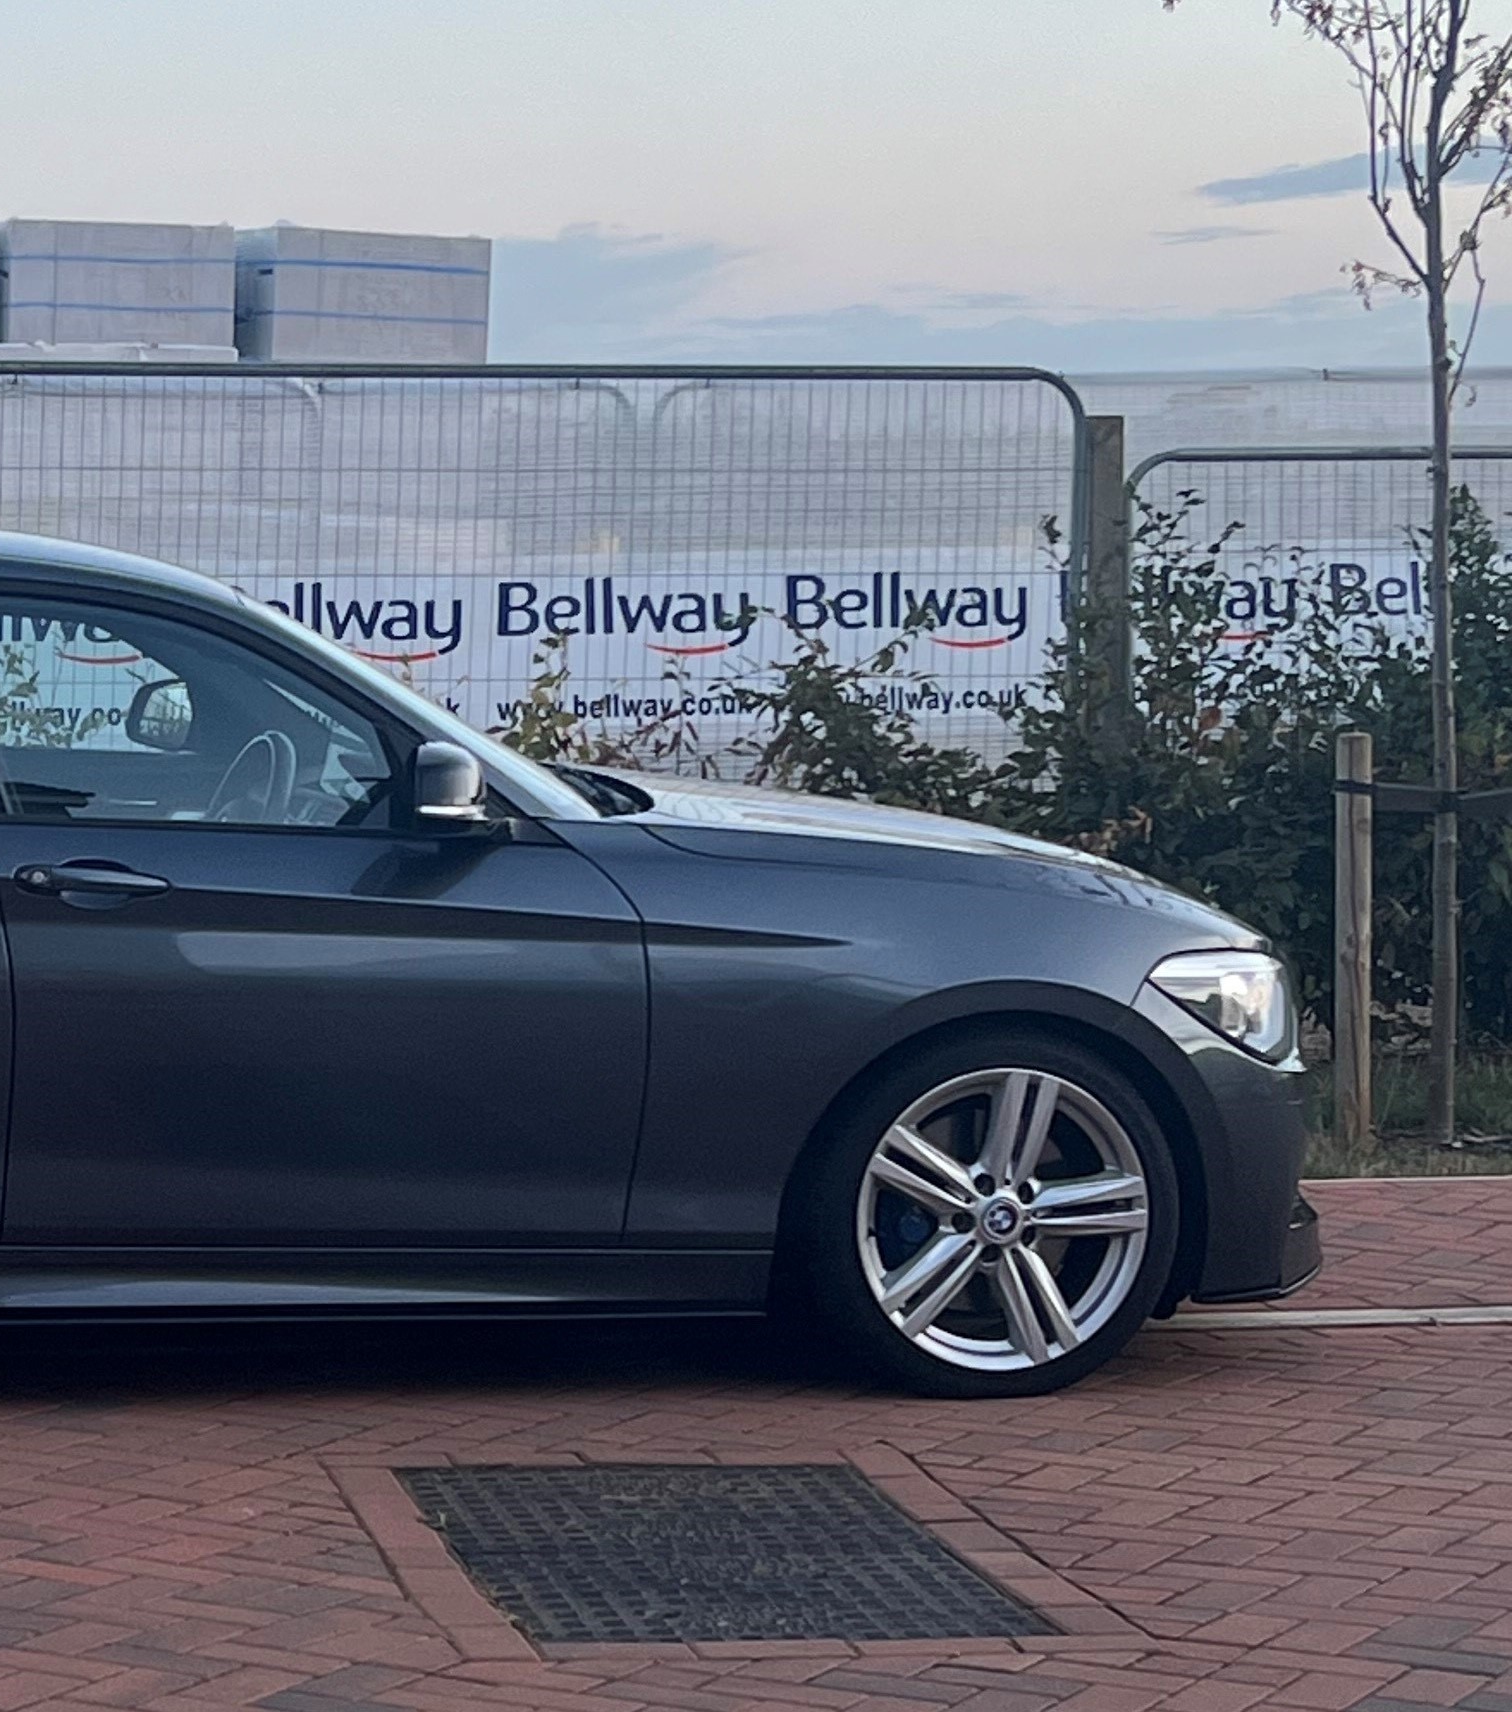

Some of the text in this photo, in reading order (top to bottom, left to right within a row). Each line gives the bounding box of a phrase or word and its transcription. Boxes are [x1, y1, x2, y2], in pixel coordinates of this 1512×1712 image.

[264, 581, 463, 656] llway
[496, 576, 756, 648] Bellway
[787, 571, 1028, 641] Bellway
